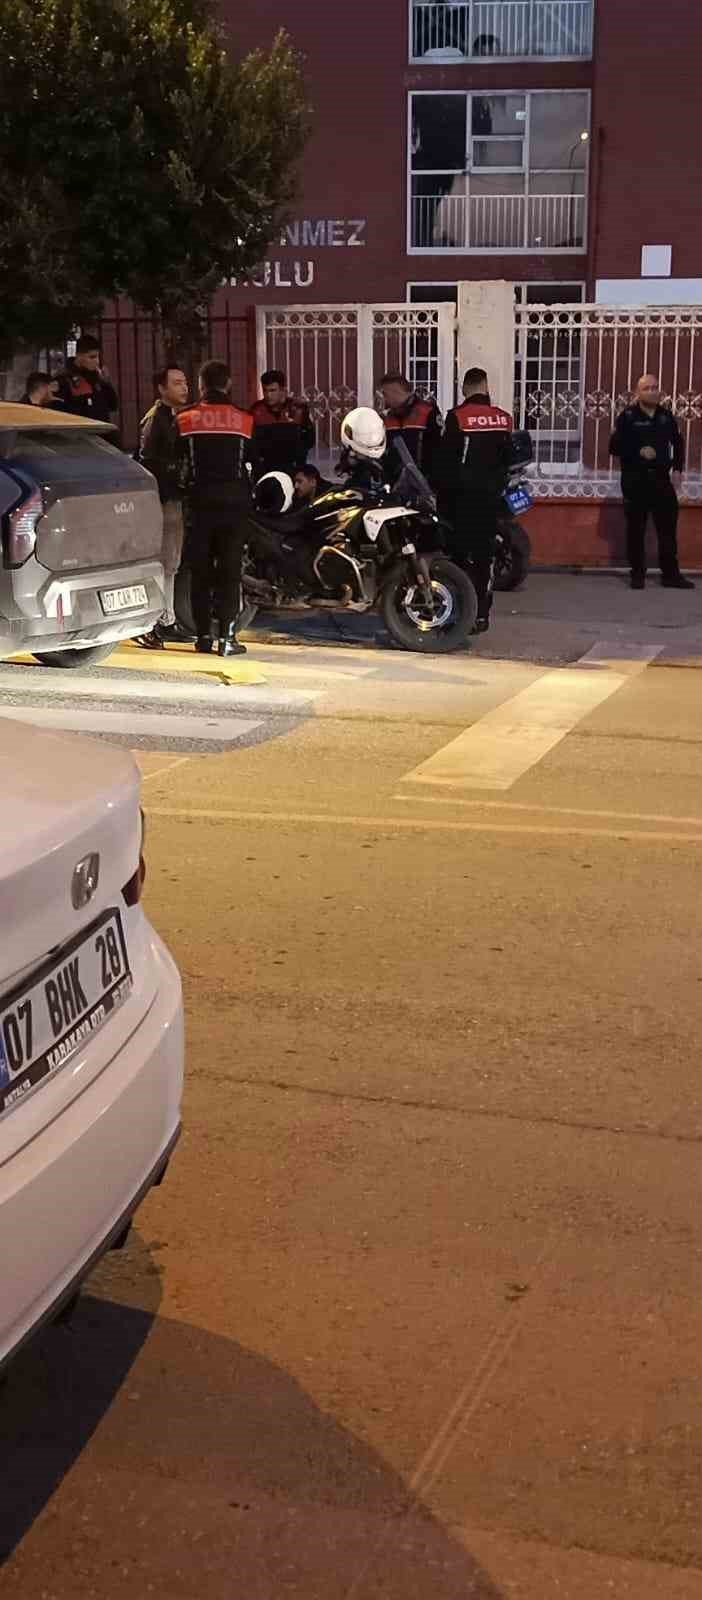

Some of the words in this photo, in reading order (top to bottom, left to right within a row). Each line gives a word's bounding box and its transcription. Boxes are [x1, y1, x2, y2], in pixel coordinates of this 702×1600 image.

[279, 220, 366, 247] NMEZ
[220, 261, 314, 287] ULU
[467, 414, 508, 426] POLİS
[2, 998, 33, 1072] 07
[45, 956, 88, 1037] BHK
[95, 926, 121, 988] 28
[46, 1017, 91, 1070] KARAKAYA
